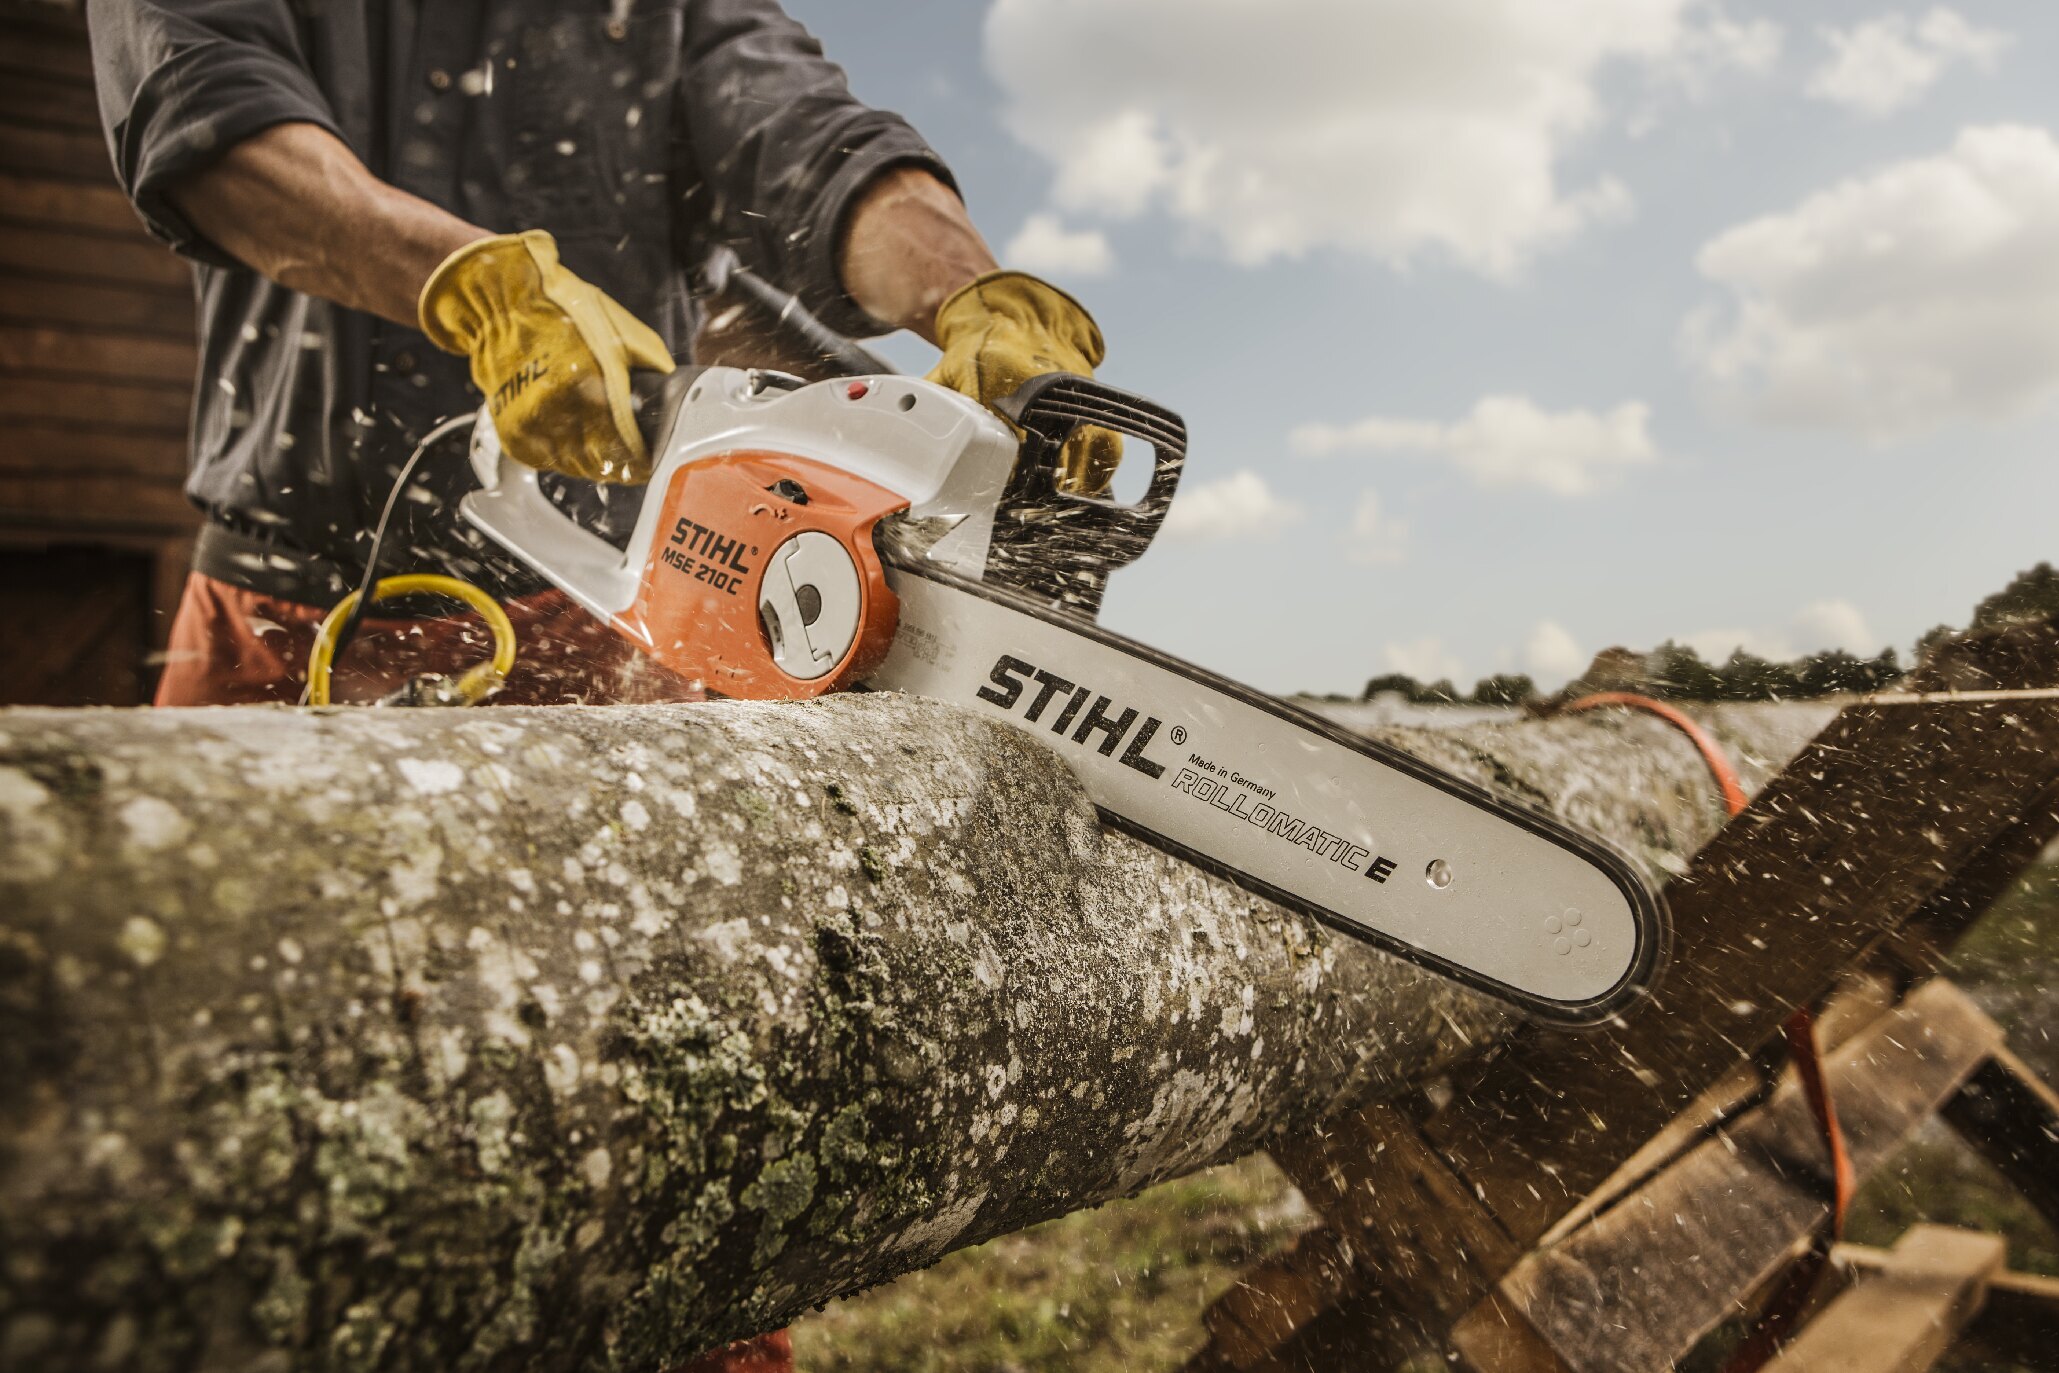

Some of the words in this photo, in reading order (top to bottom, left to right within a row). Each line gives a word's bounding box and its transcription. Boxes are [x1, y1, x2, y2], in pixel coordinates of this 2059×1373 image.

[661, 547, 695, 574] MSE
[1188, 754, 1215, 773] Made
[1217, 766, 1227, 778] in
[1230, 772, 1276, 801] Germany
[1171, 768, 1369, 871] ROLLOMATIC
[1364, 856, 1397, 884] E
